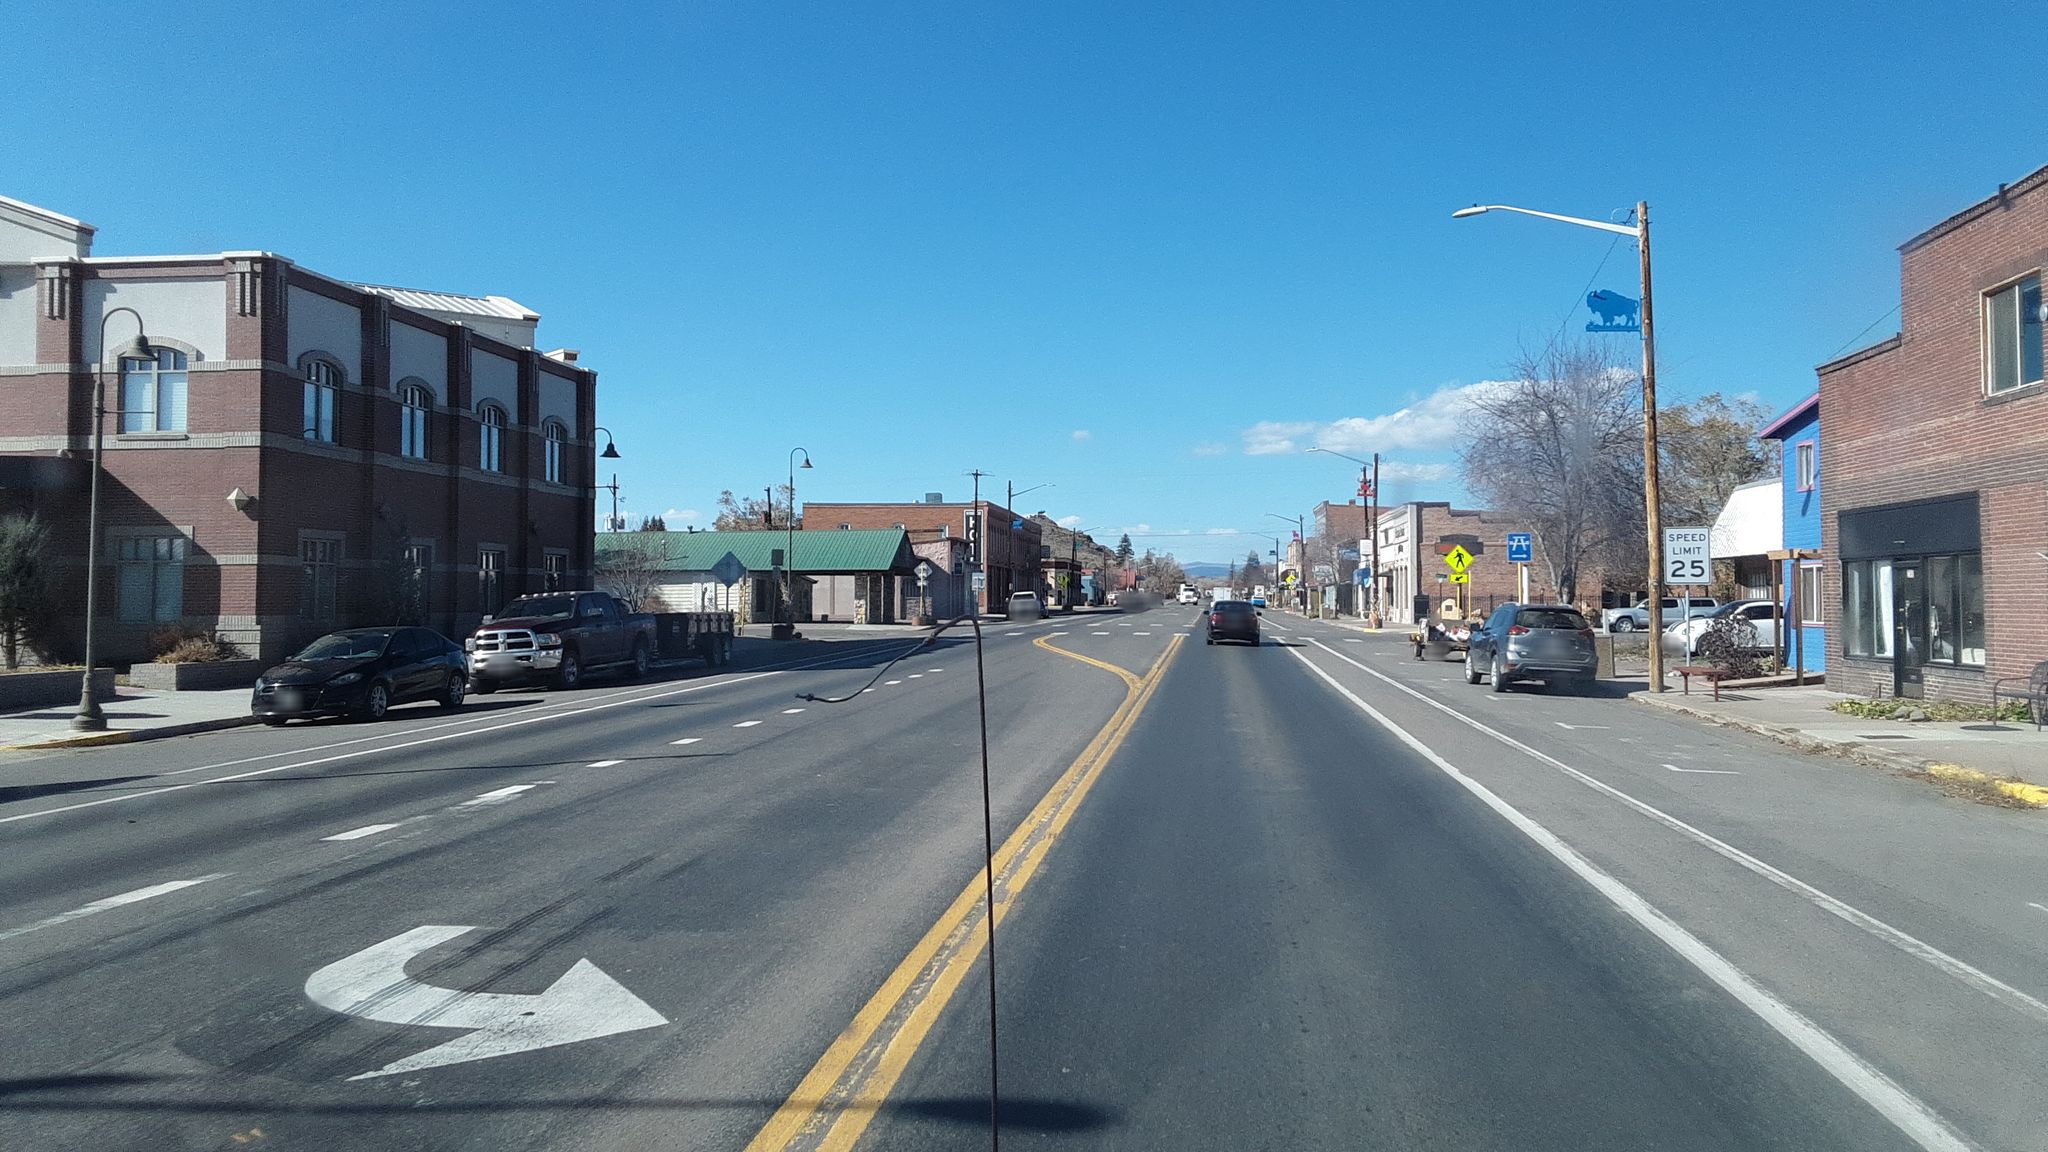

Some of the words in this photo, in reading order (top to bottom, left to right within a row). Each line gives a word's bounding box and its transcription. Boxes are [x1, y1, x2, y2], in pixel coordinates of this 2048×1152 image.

[1668, 533, 1706, 542] SPEED
[1672, 546, 1702, 555] LIMIT
[1670, 560, 1705, 578] 25
